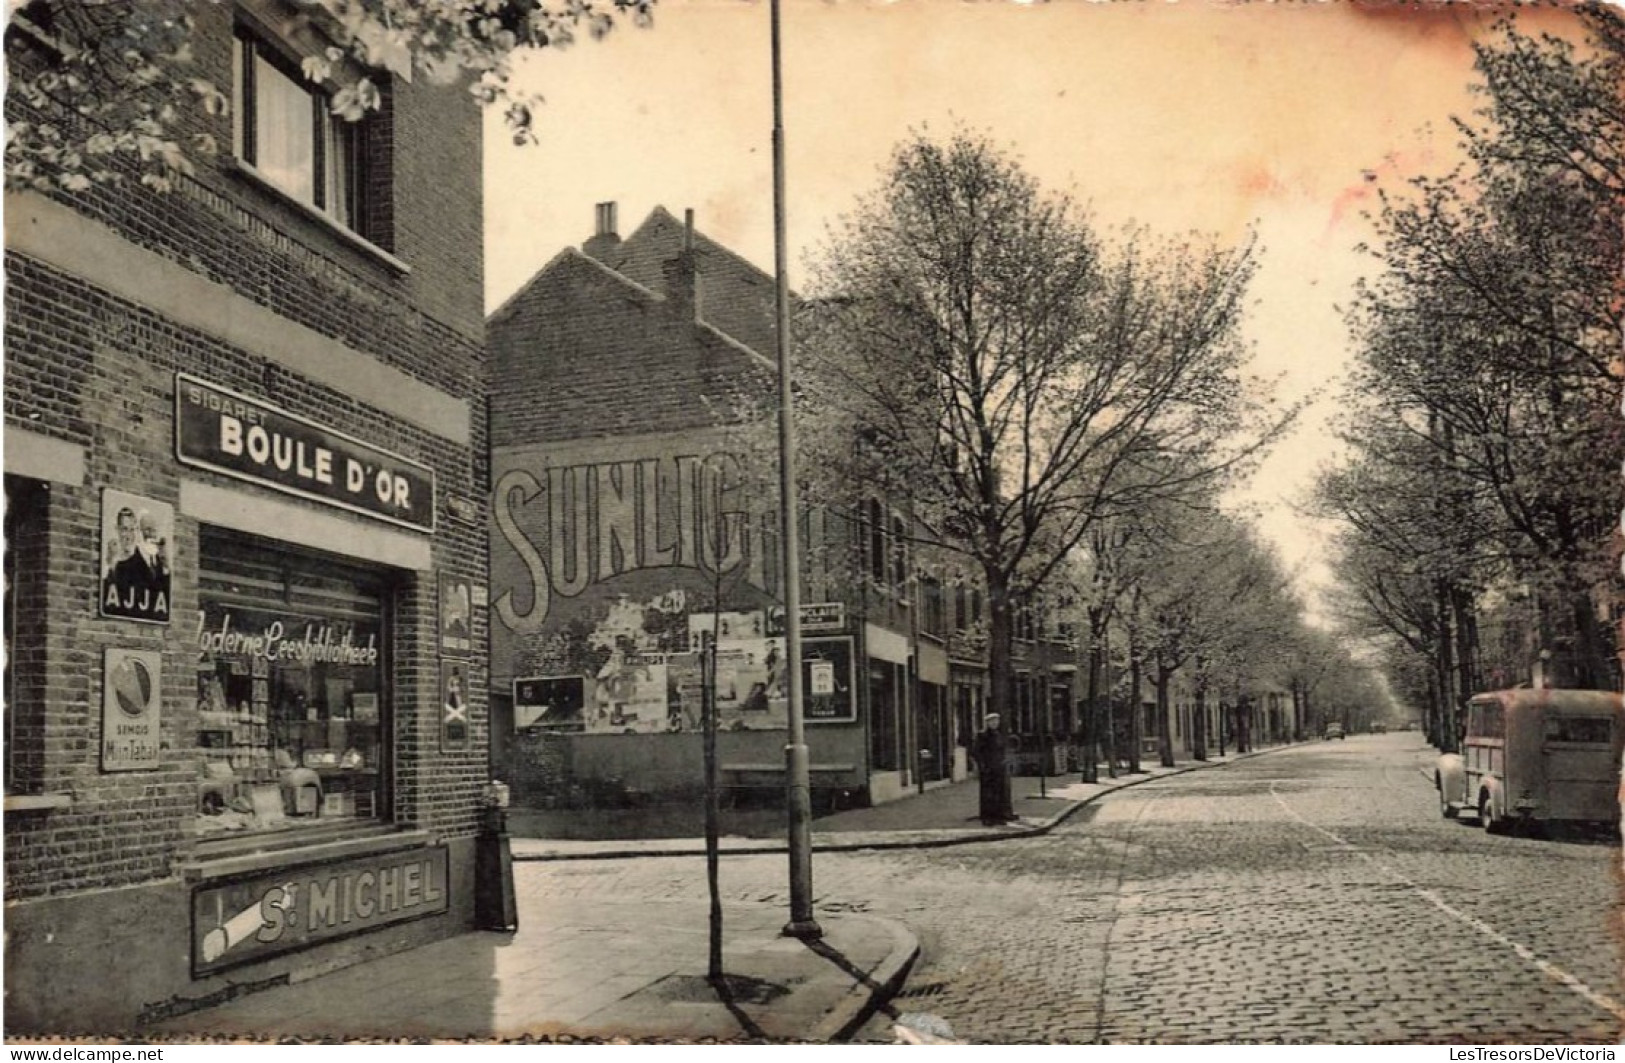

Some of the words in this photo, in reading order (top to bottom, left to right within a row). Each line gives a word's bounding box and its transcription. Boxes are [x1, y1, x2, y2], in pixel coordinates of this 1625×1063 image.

[189, 387, 267, 427] SIGARET
[220, 414, 333, 485] BOULE
[346, 458, 410, 510] D'OR
[105, 583, 168, 614] AJJA
[307, 860, 441, 933] MICHEL
